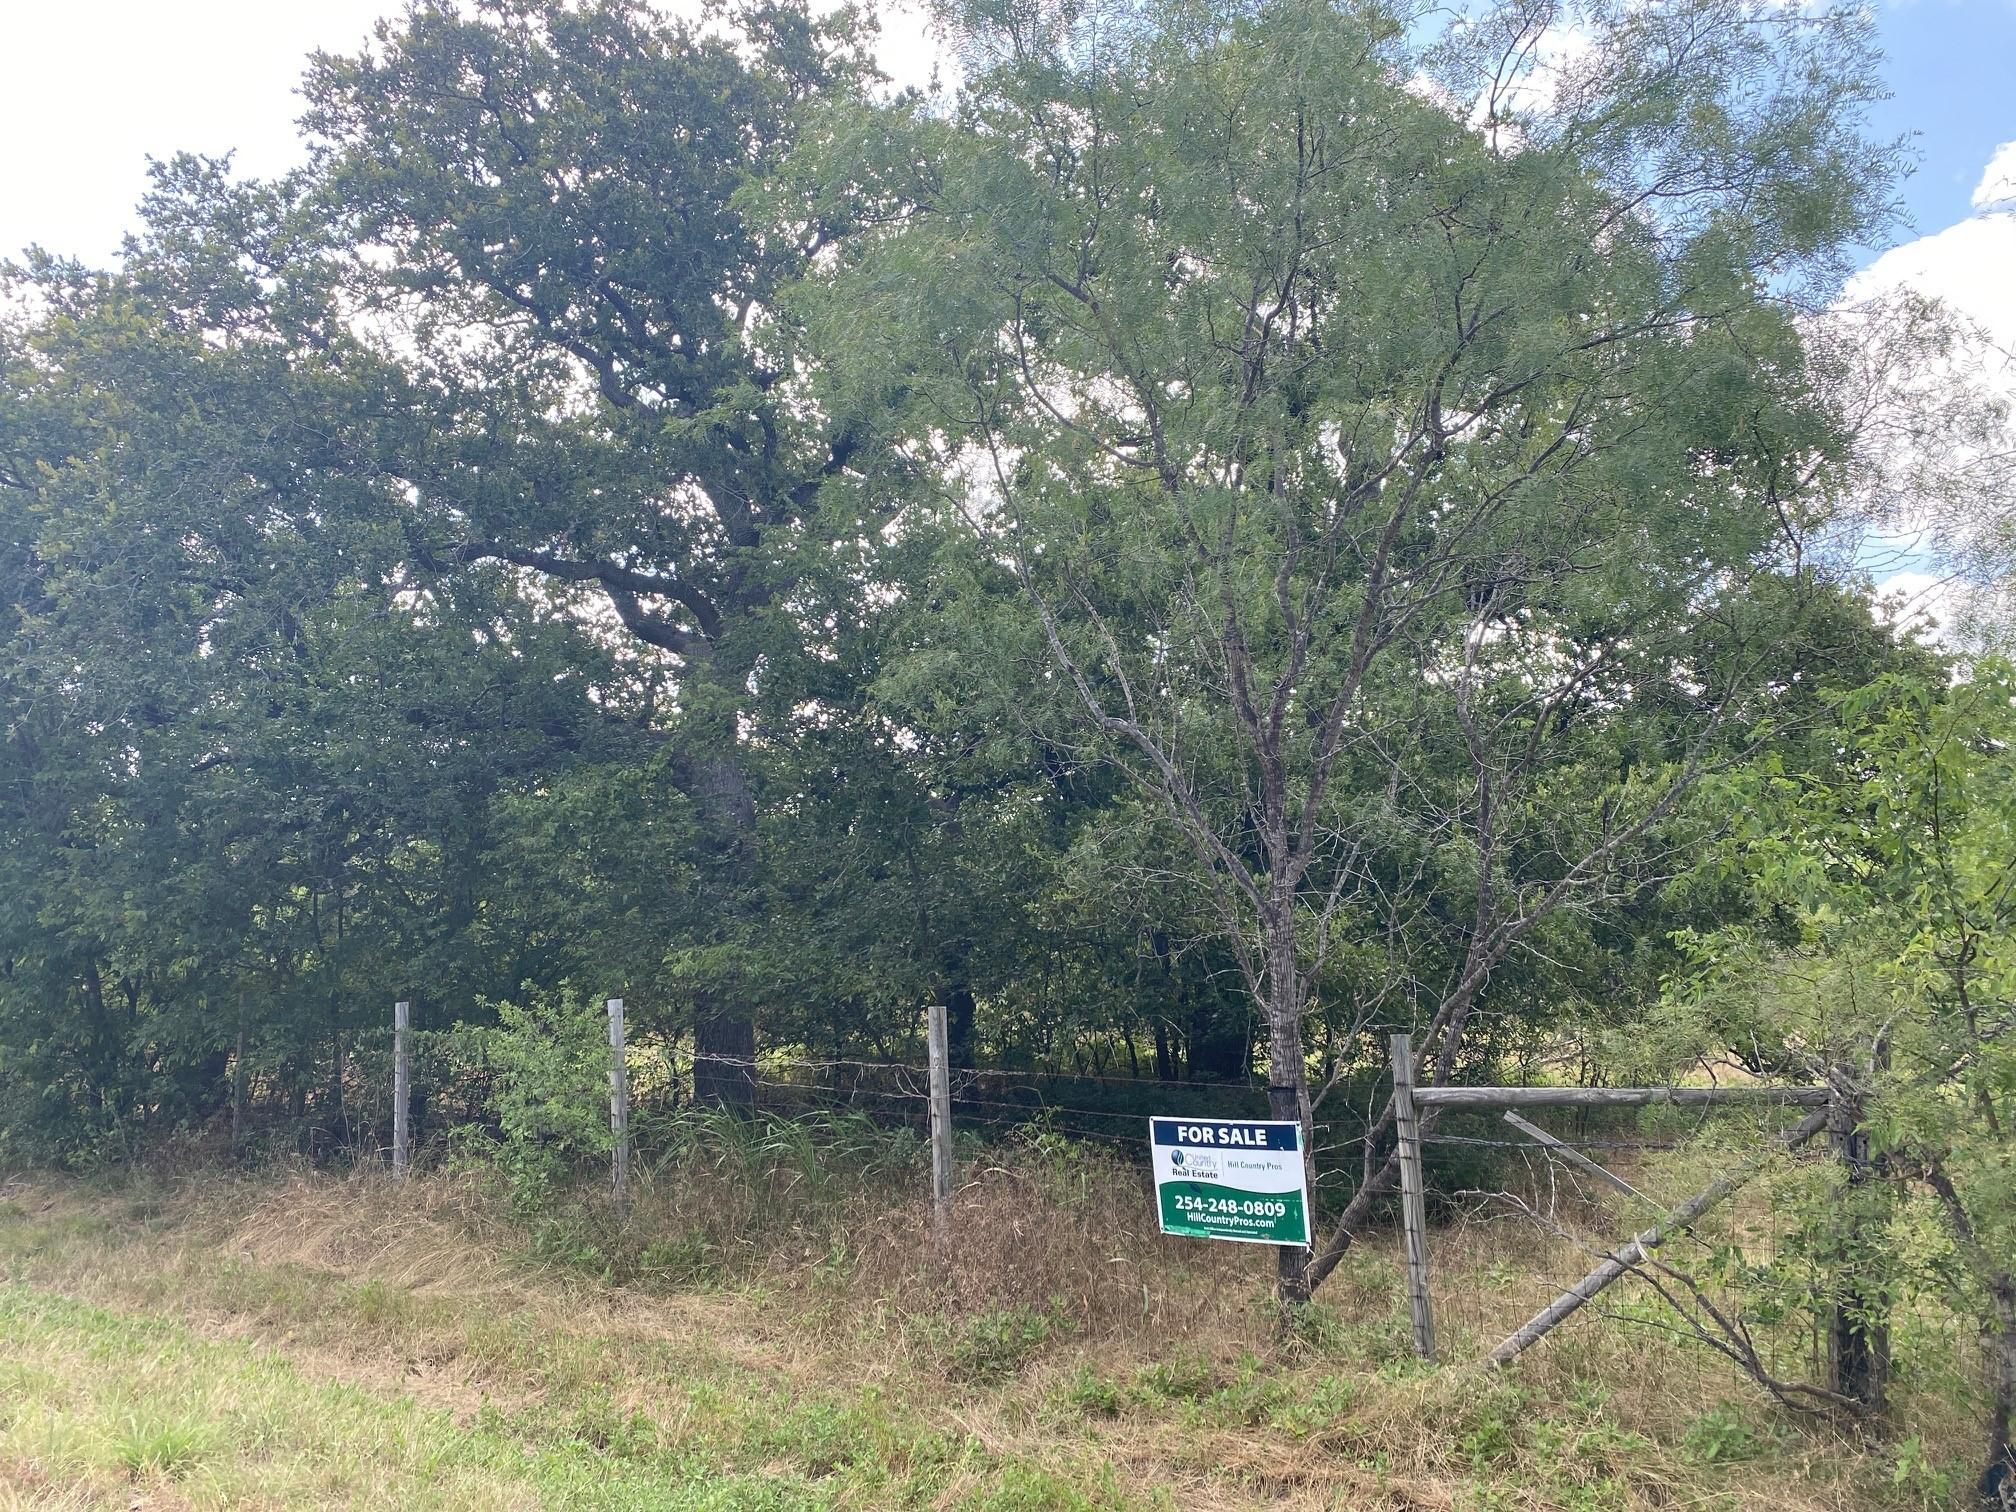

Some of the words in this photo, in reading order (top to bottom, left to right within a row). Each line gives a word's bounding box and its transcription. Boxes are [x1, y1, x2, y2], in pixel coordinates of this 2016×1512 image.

[1178, 1126, 1214, 1143] FOR
[1219, 1128, 1267, 1146] SALE
[1173, 1168, 1189, 1177] Real
[1192, 1171, 1218, 1179] Estate
[1241, 1161, 1265, 1171] Country
[1175, 1195, 1285, 1216] 254-248-0809
[1187, 1212, 1274, 1228] HillCountryPros.com
